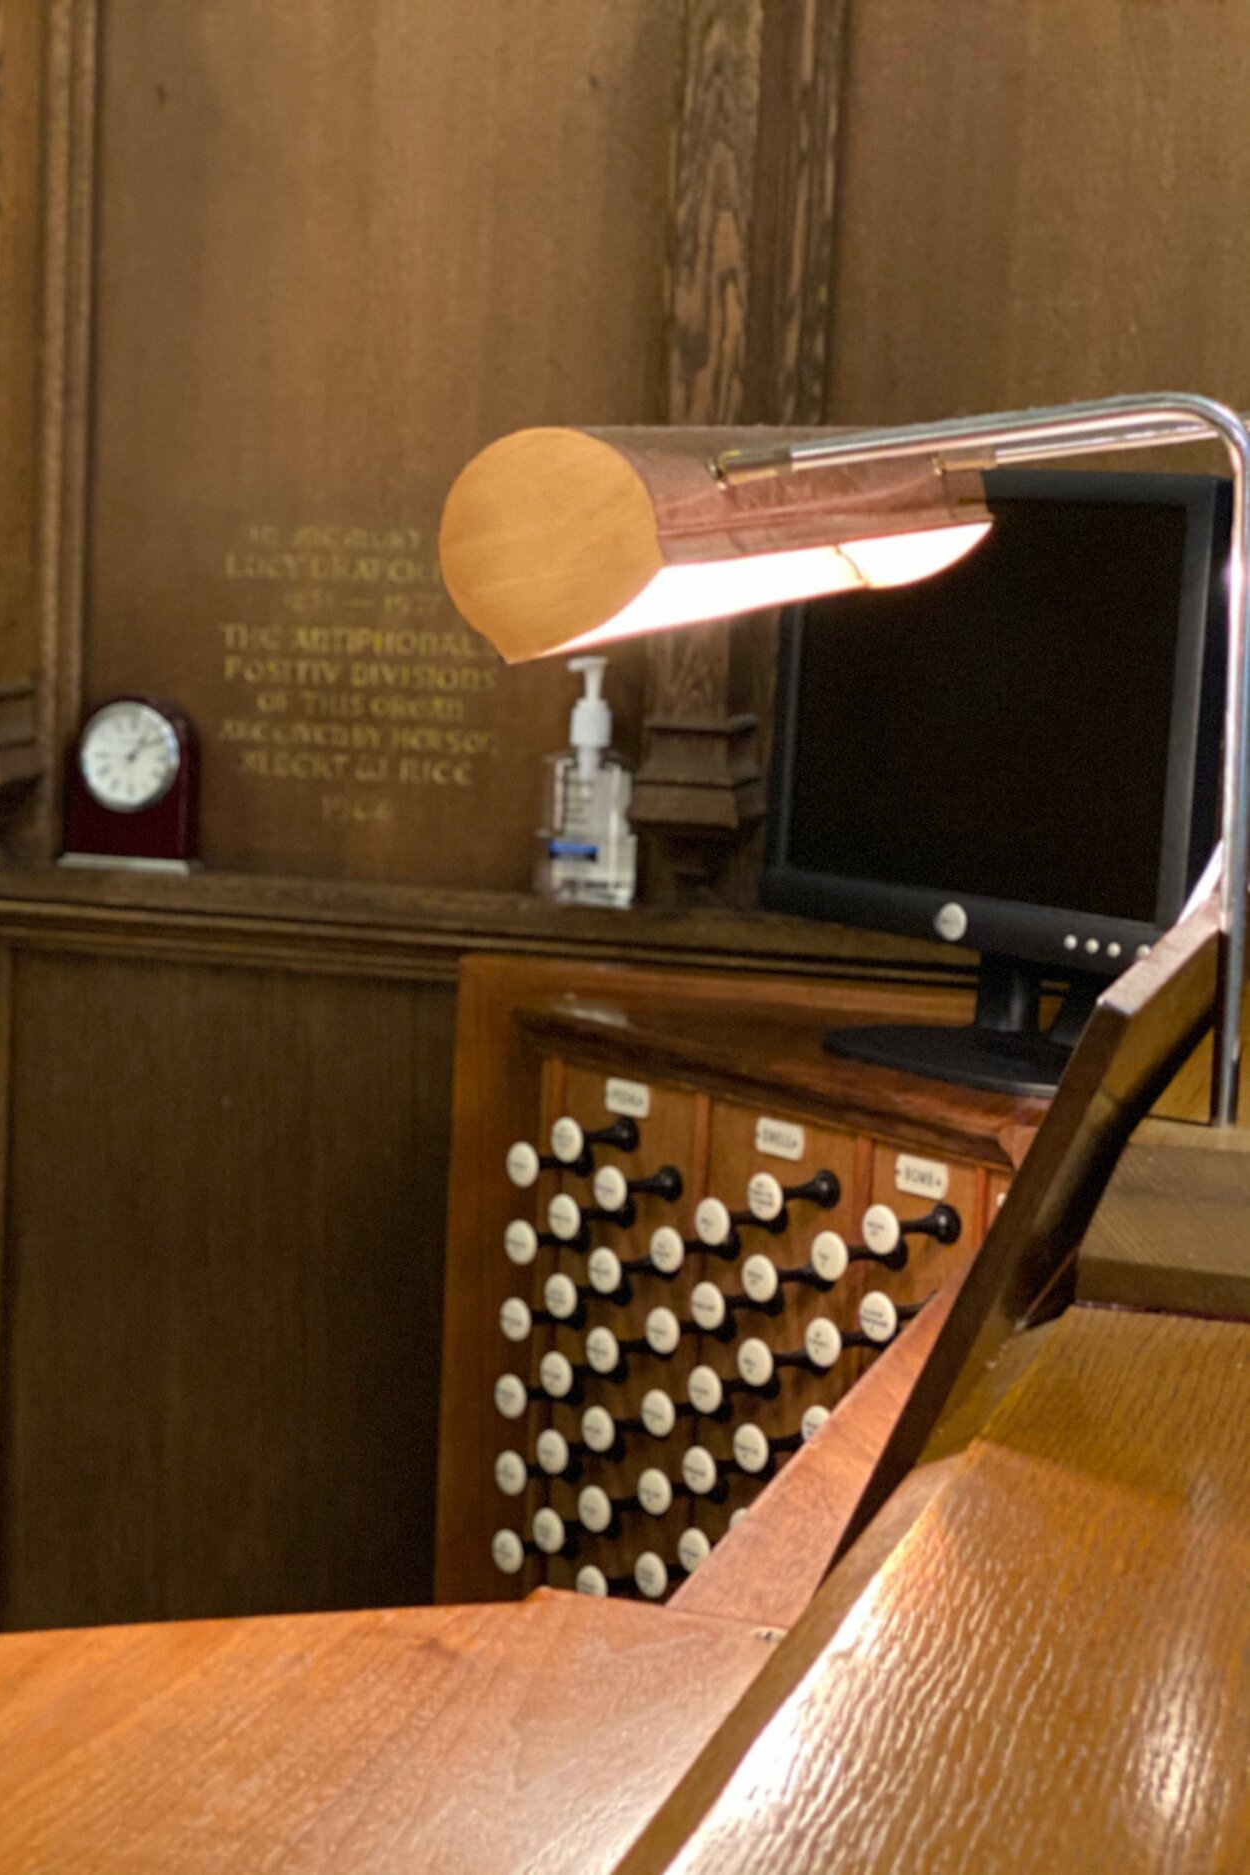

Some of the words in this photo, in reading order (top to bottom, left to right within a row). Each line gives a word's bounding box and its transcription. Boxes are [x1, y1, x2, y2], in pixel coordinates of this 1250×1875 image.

[220, 623, 282, 652] THE
[293, 626, 477, 660] ANTIPHONAL
[222, 654, 342, 687] POSITIV
[349, 660, 500, 694] DIVISIONS
[255, 690, 291, 714] OF
[300, 690, 367, 718] THIS
[369, 693, 466, 723] ORGAN
[398, 756, 478, 788] RICE
